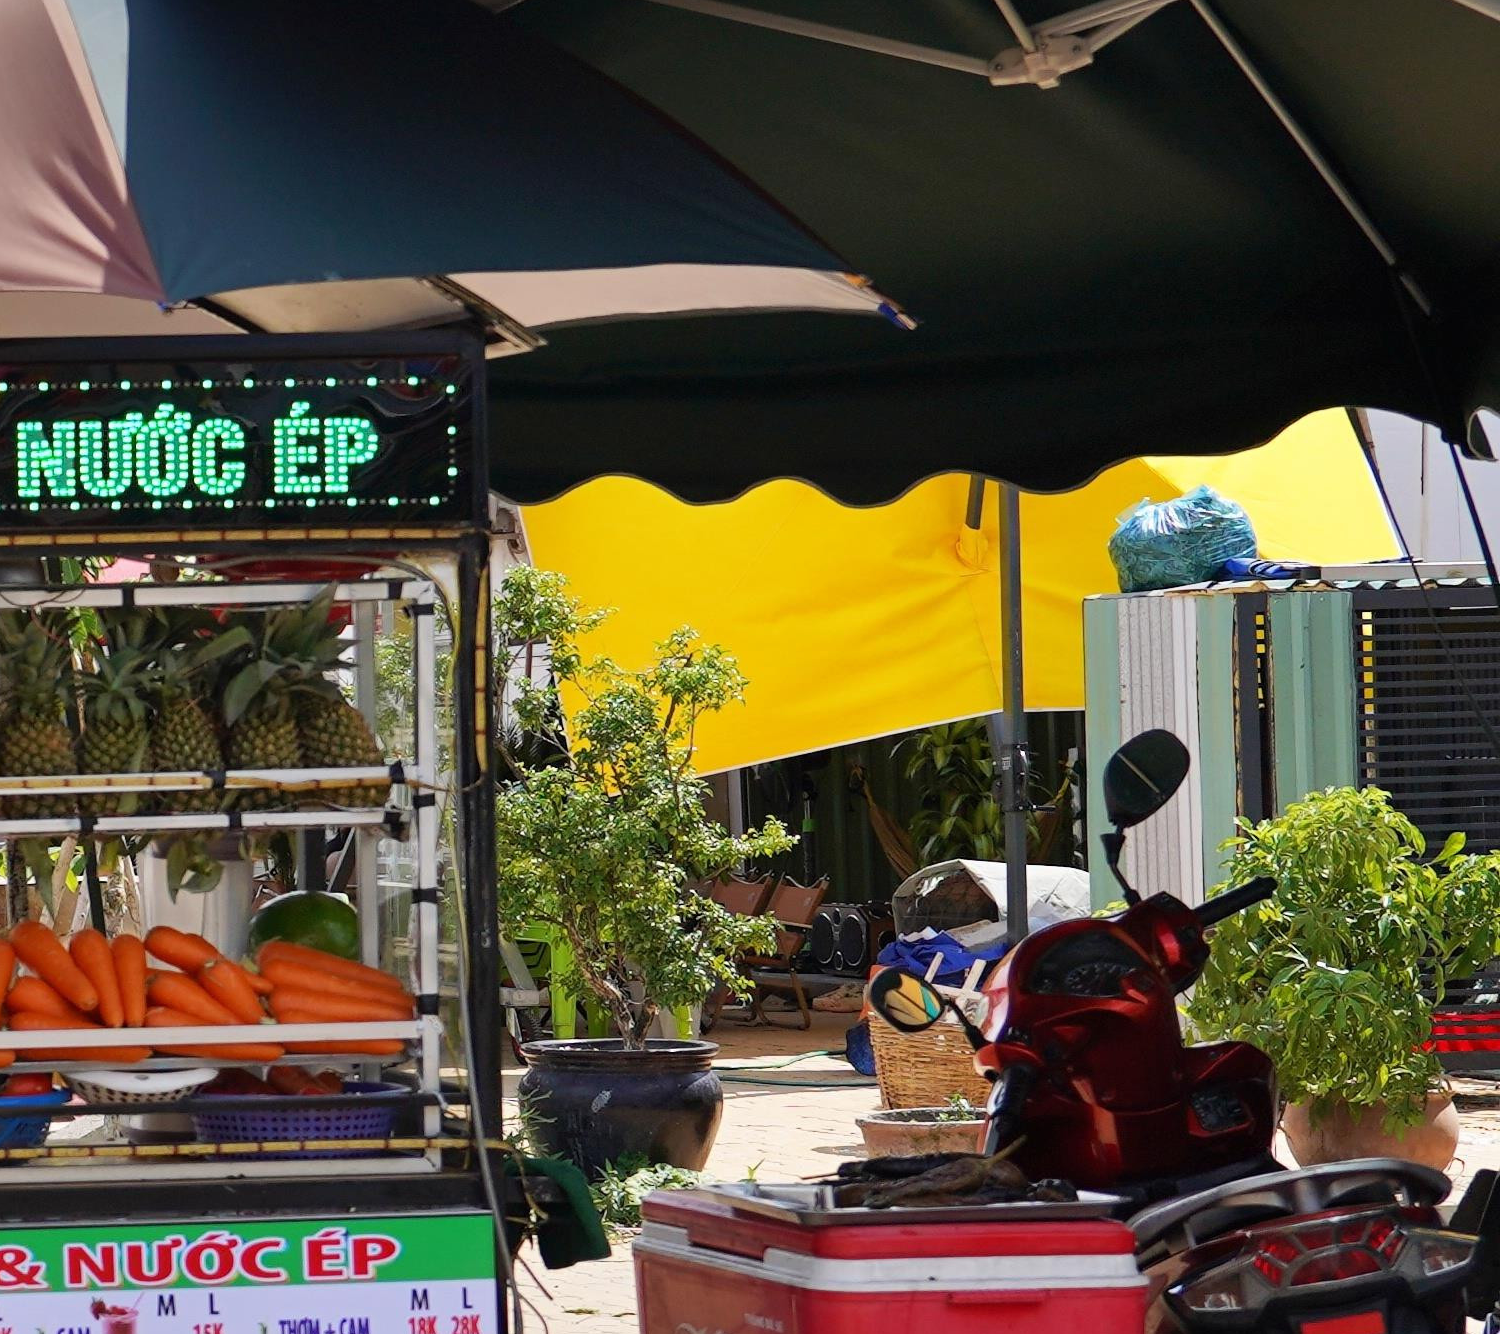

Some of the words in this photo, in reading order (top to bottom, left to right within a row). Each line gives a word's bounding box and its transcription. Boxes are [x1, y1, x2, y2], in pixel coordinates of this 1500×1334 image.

[17, 403, 246, 498] NƯỚC
[273, 401, 379, 494] ÉP
[64, 1232, 286, 1287] NƯỚC
[305, 1228, 399, 1279] ÉP
[157, 1294, 176, 1316] M
[209, 1293, 220, 1315] L
[411, 1289, 429, 1310] M
[462, 1287, 473, 1309] L
